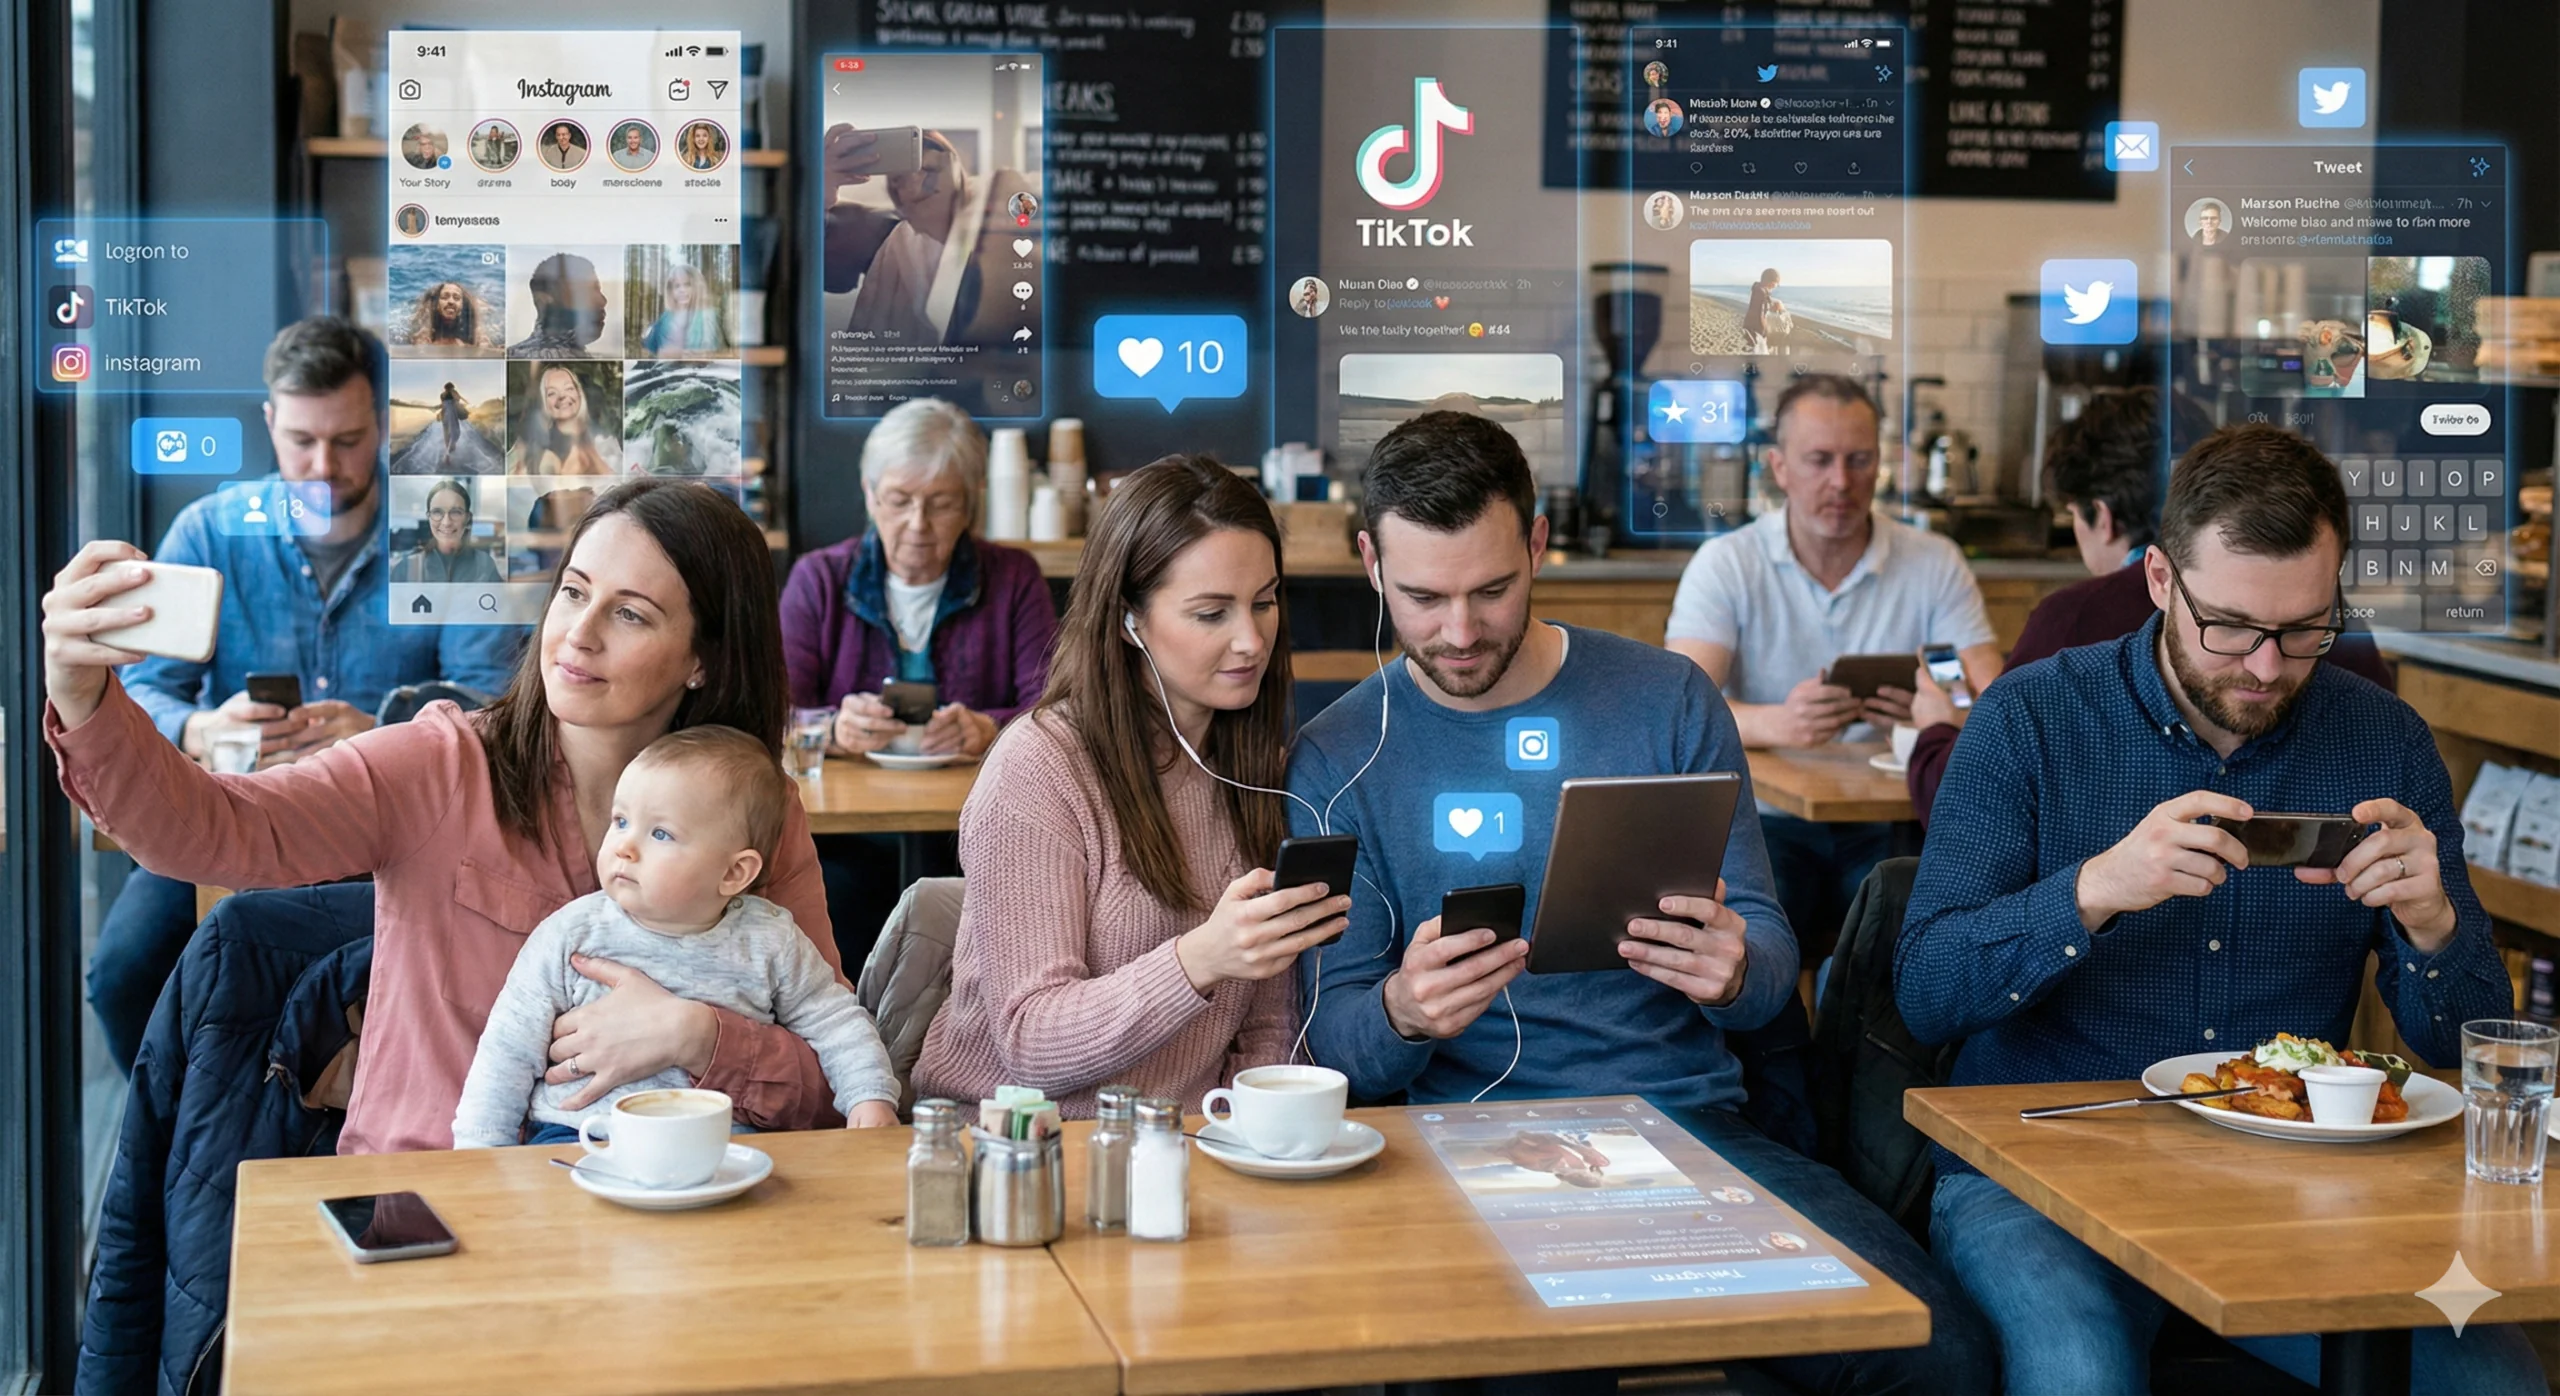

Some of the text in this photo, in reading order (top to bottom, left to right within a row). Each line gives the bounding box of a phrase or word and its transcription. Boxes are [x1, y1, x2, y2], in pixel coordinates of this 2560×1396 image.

[417, 45, 447, 58] 9:41
[517, 78, 613, 106] Instagram
[2313, 160, 2364, 175] Tweet
[399, 178, 451, 189] Your Story
[2456, 197, 2473, 209] 7h
[2330, 216, 2354, 228] and
[2396, 216, 2410, 228] to
[2439, 217, 2472, 228] more
[1355, 218, 1475, 248] TikTok
[170, 242, 190, 260] to
[105, 297, 169, 317] TikTok
[105, 353, 202, 376] instagram
[2348, 471, 2361, 487] Y
[2381, 471, 2396, 487] U
[2447, 471, 2463, 487] O
[2483, 471, 2496, 487] P
[2366, 516, 2479, 532] H J K L
[2366, 560, 2448, 576] B N M
[2445, 606, 2485, 619] return
